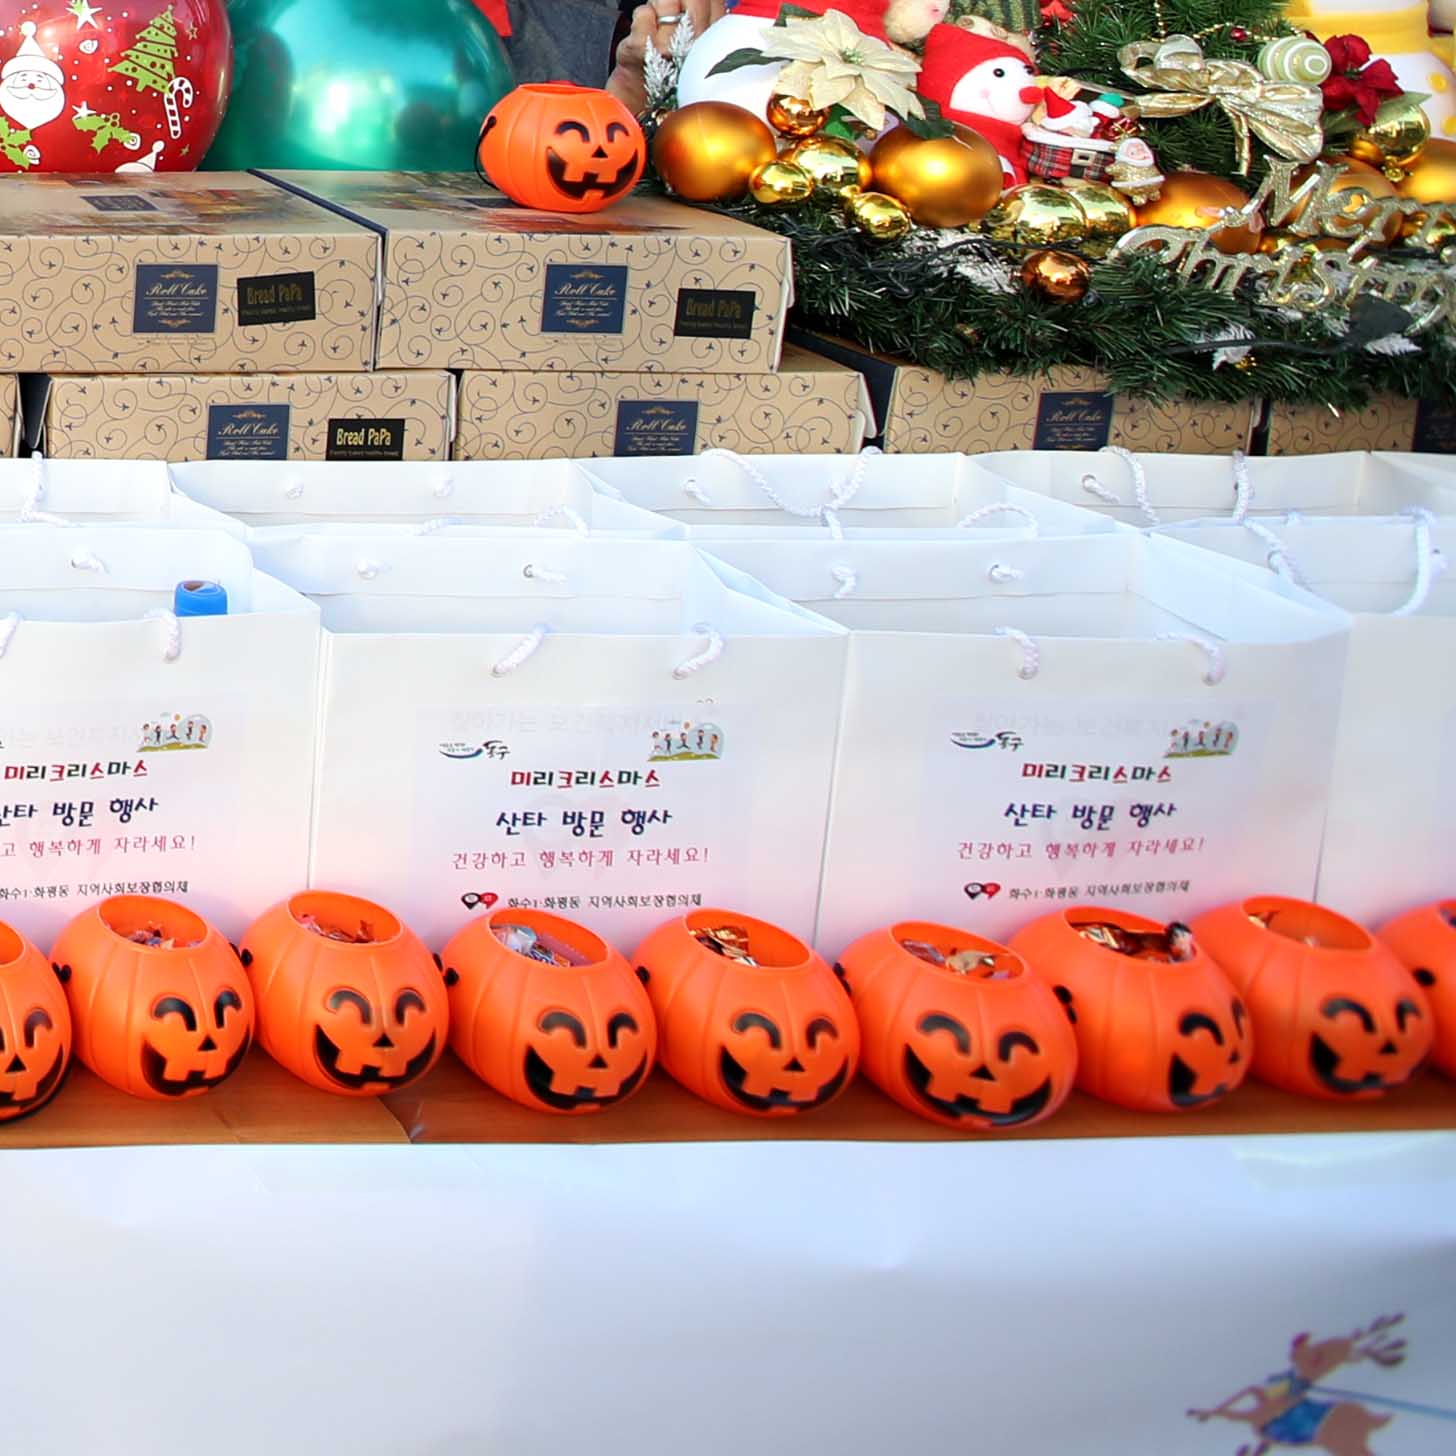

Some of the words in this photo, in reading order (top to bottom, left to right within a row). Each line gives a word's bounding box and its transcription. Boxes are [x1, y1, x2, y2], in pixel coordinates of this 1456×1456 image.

[146, 282, 178, 295] Roll
[179, 283, 207, 295] Cake
[555, 282, 588, 296] Roll
[589, 284, 616, 296] Cake
[218, 422, 251, 435] Roll
[252, 424, 278, 435] Cake
[626, 418, 659, 431] Roll
[660, 419, 687, 431] Cake
[337, 428, 364, 445] Bread
[368, 428, 391, 446] PaPa
[4, 760, 148, 781] 미리크리스마스
[511, 770, 660, 788] 미리크리스마스
[1022, 763, 1171, 783] 미리크리스마스
[53, 801, 94, 827] 방문
[110, 797, 158, 824] 행사
[1005, 803, 1057, 827] 산타
[1072, 804, 1114, 831] 방문
[1129, 803, 1176, 828] 행사
[496, 811, 547, 835] 산타
[562, 811, 605, 838] 방문
[621, 809, 672, 835] 행사
[30, 839, 101, 858] 행복하게
[114, 836, 196, 853] 자라세요!
[958, 842, 1031, 860] 건강하고
[1046, 842, 1115, 859] 행복하게
[1128, 837, 1205, 855] 자라세요!
[453, 852, 526, 869] 건강하고
[540, 850, 613, 868] 행복하게
[627, 848, 709, 865] 자라세요!
[77, 881, 188, 897] 지역사회보장협의체
[589, 895, 701, 909] 지역사회보장협의체
